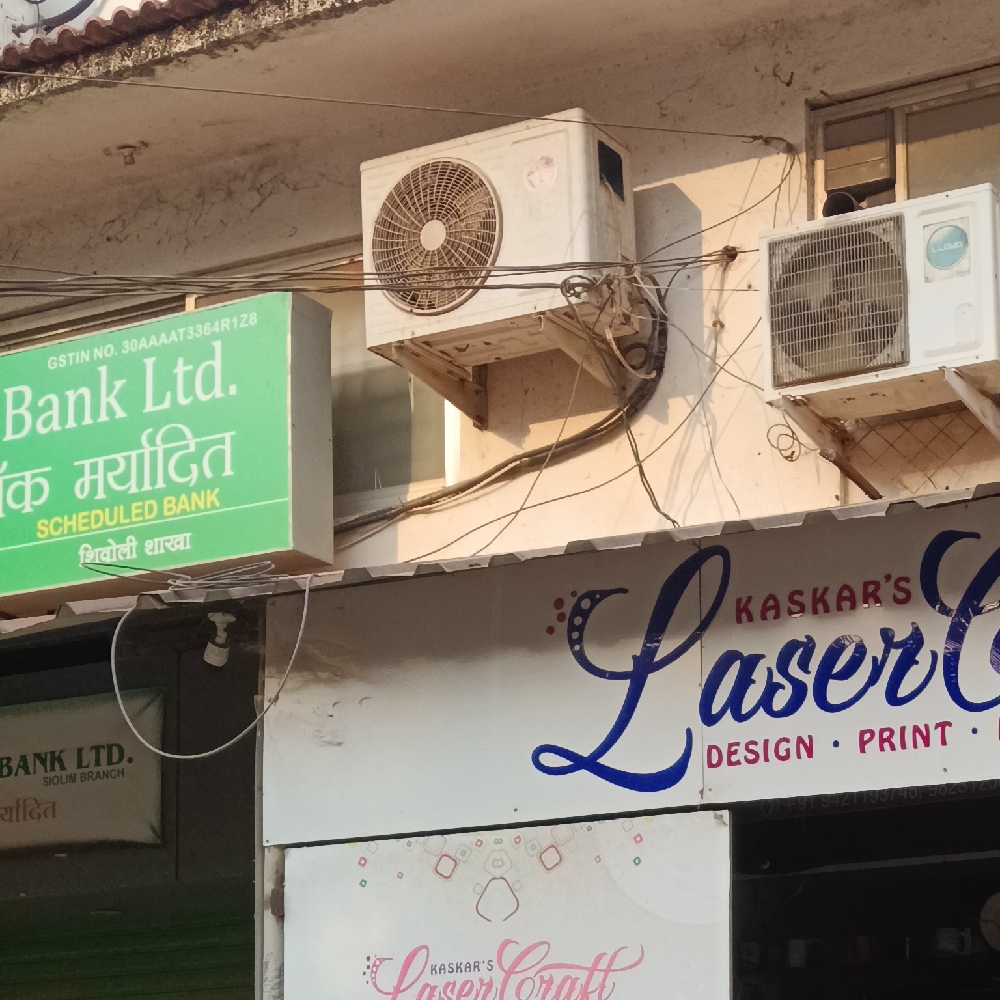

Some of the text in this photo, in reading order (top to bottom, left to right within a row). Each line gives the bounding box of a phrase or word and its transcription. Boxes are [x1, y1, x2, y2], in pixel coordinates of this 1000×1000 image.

[47, 311, 258, 370] GSTIN NO. 30AAAAT3364R1Z8
[2, 339, 237, 442] Bank Ltd.
[73, 423, 236, 500] मर्यादित
[36, 488, 220, 539] SCHEDULED BANK
[78, 532, 192, 565] शिवोली शाखा
[735, 573, 912, 625] KASKAR'S
[0, 743, 134, 779] BANK LTD.
[706, 734, 815, 769] DESIGN
[858, 720, 953, 754] PRINT
[43, 767, 125, 787] SIOLIM BRANCH
[430, 960, 494, 975] KASKAR'S
